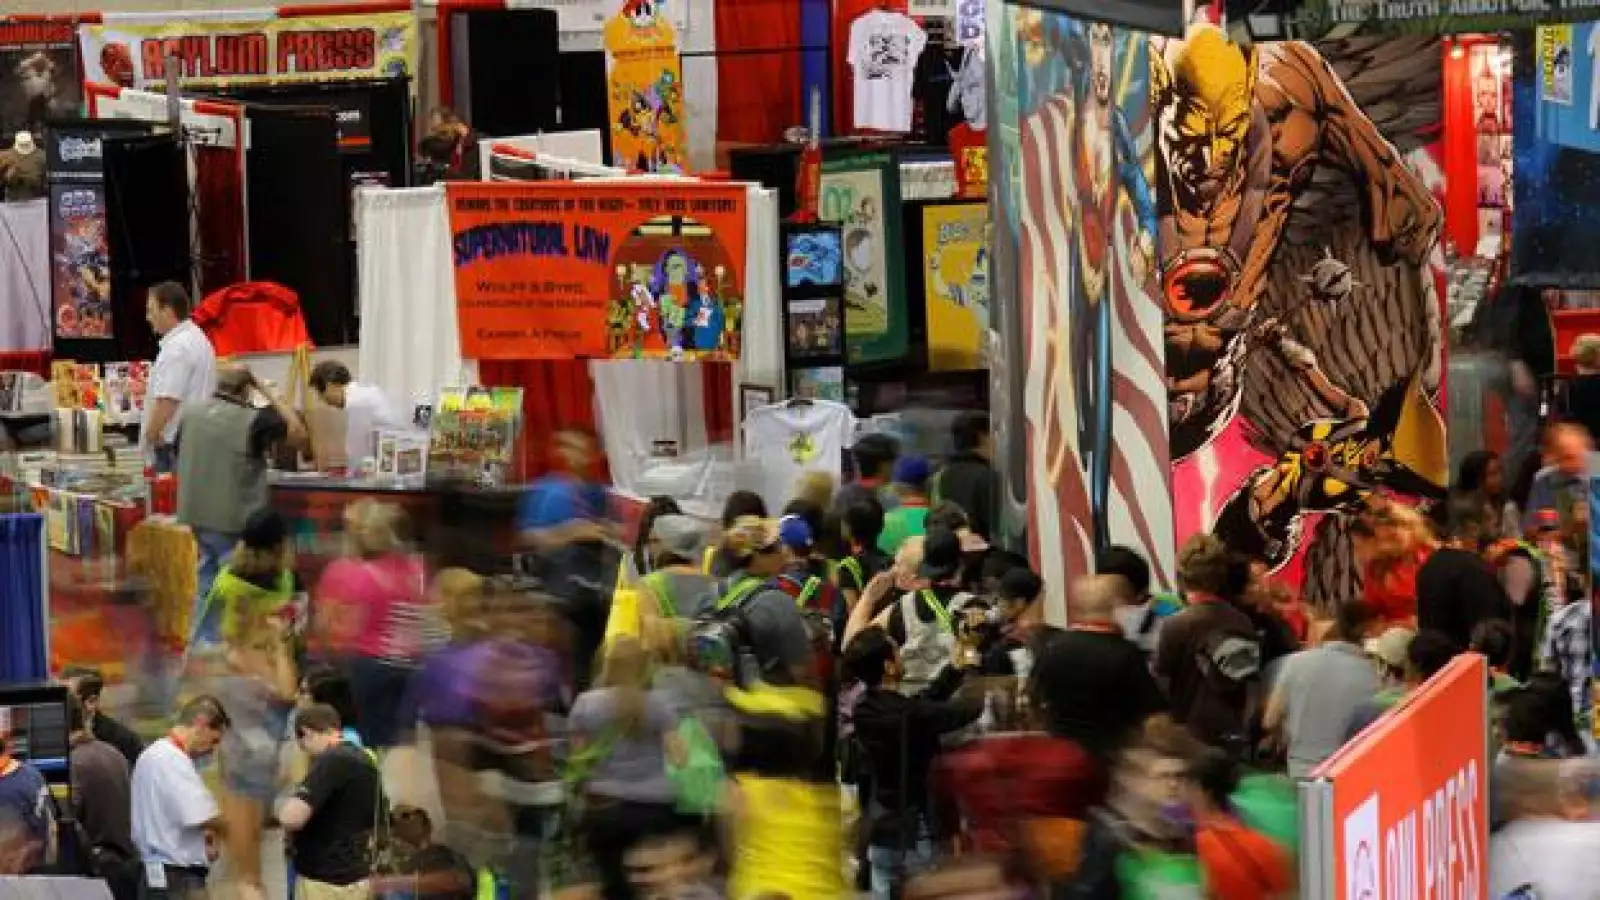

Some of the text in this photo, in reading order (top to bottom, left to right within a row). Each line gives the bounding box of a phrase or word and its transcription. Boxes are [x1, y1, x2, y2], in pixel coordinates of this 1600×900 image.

[141, 27, 376, 80] ASYLUM PRESS
[453, 221, 610, 268] SUPERNATURAL LAW
[1423, 758, 1480, 900] PRESS
